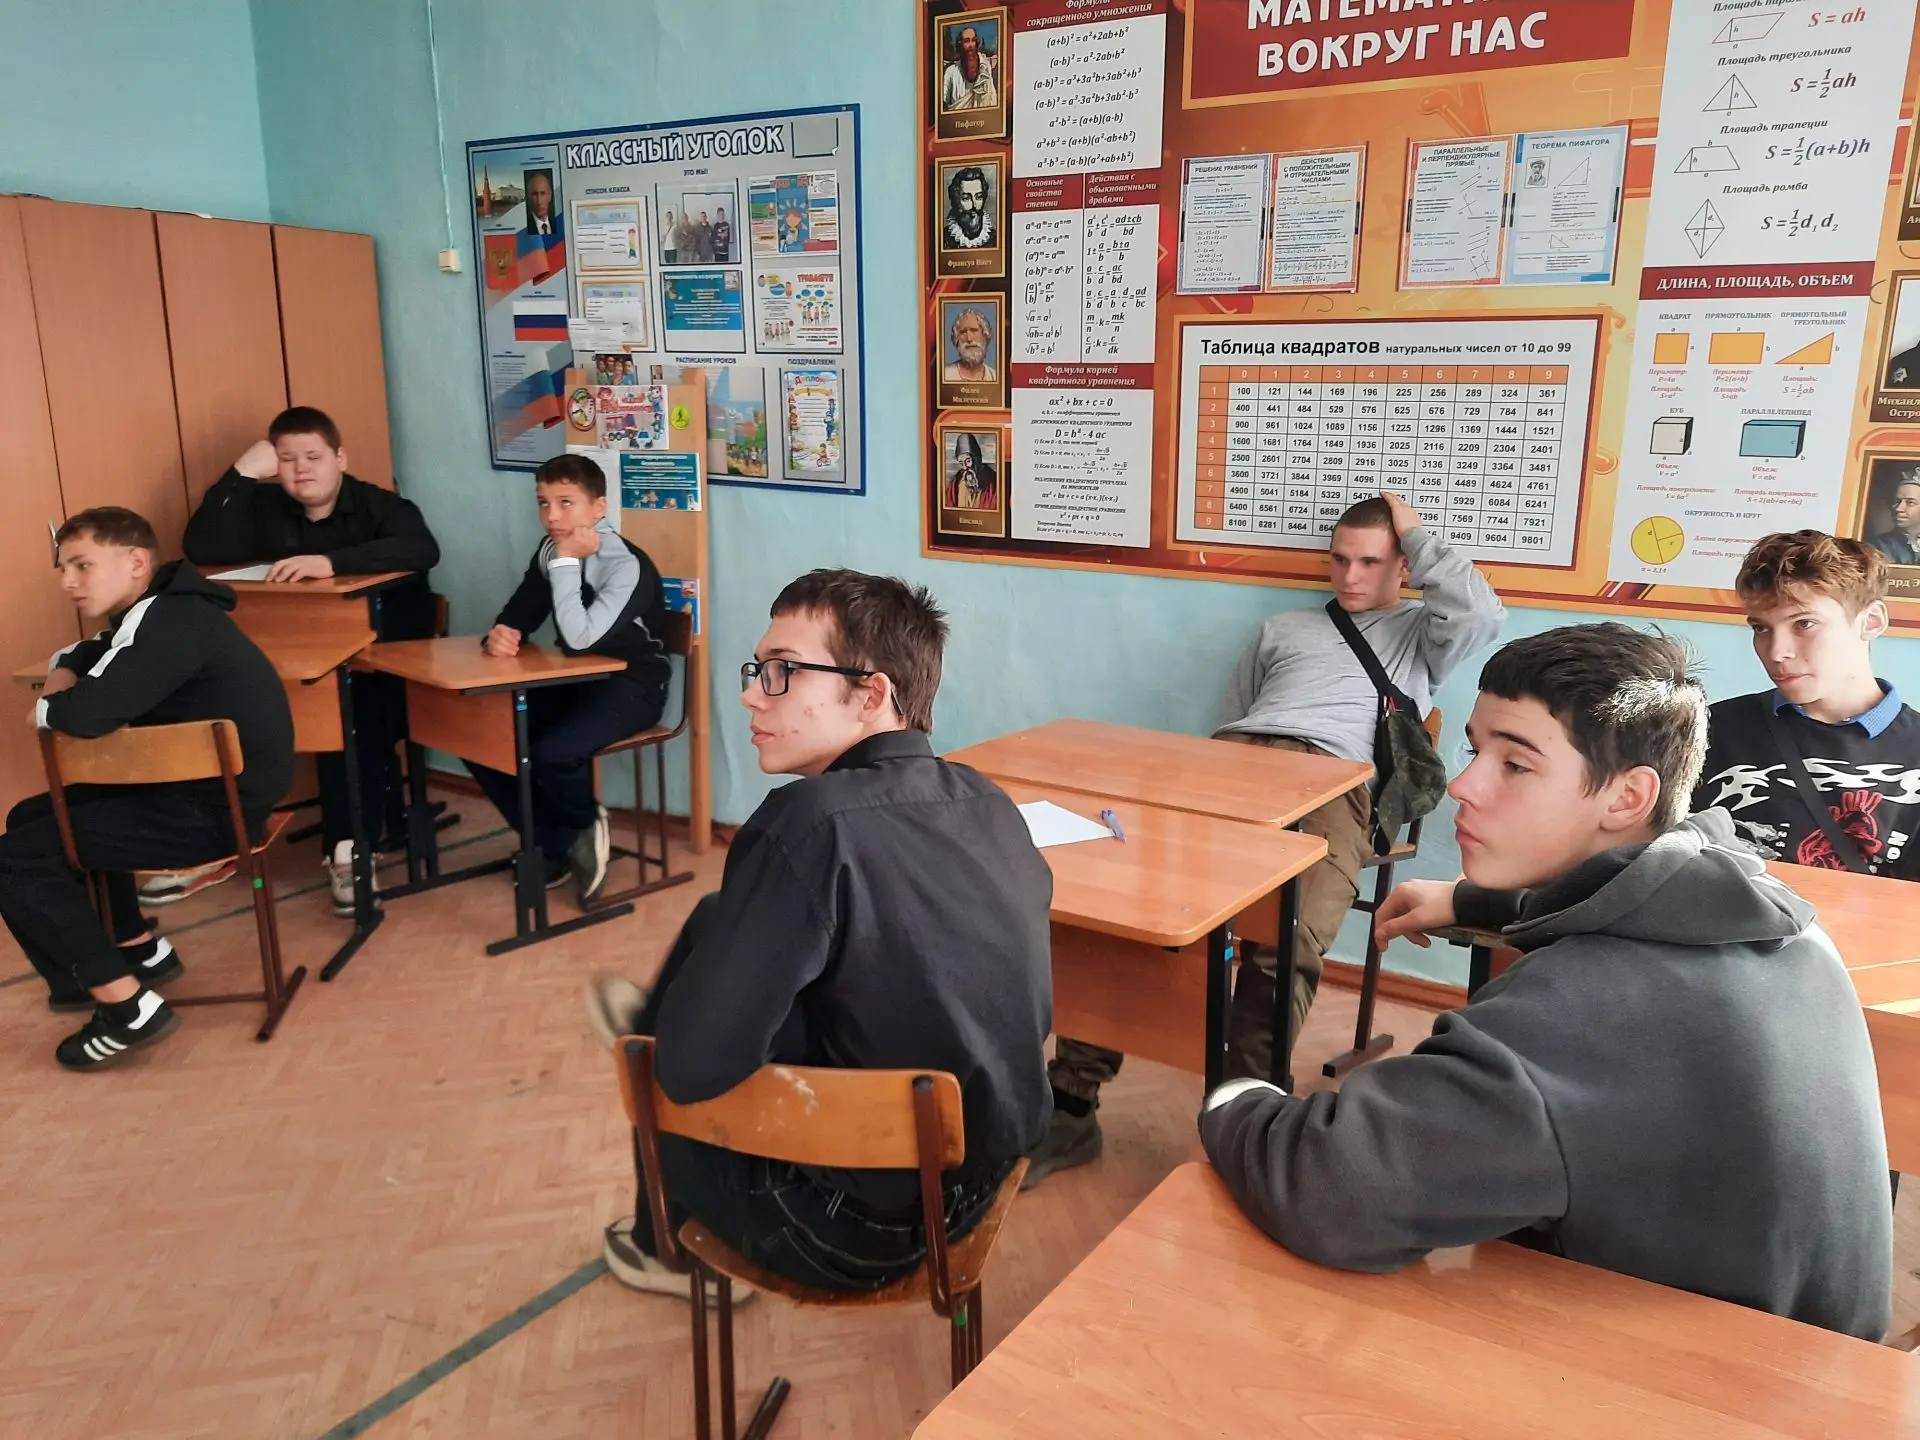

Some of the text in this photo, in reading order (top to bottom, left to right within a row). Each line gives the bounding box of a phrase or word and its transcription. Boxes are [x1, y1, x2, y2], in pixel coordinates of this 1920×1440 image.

[1026, 3, 1153, 27] сокращенного умножения
[1258, 12, 1547, 77] ВОКРУГ НАС
[1717, 45, 1852, 67] Площадь треугольника
[955, 120, 985, 129] Пифагор
[1720, 119, 1828, 135] Площадь трапеции
[566, 124, 784, 169] КЛАССНЫЙ УГОЛОК
[1532, 138, 1610, 150] ТЕОРЕМА ПИФАГОРА
[1433, 145, 1489, 155] ПАРАЛЛЕЛЬНЫЕ
[1195, 163, 1258, 173] РЕШЕНИЕ УРАВНЕНИЙ
[1289, 169, 1349, 178] ОТРИЦАТЕЛЬНЫМИ
[1025, 178, 1064, 188] Основные
[1088, 174, 1129, 184] Действия
[1025, 189, 1062, 198] свойства
[1088, 183, 1157, 194] обыкновенными
[1722, 182, 1808, 195] Площадь ромба
[1088, 196, 1124, 205] дробями
[1656, 274, 1854, 291] ДЛИНА, ПЛОЩАДЬ, ОБЪЕМ
[1705, 312, 1773, 320] ПРЯМОУГОЛЬНИК
[1201, 339, 1572, 358] Таблица квадратов натуральных чисел от 10 до 99
[1045, 366, 1118, 378] Формула корней
[1028, 376, 1135, 387] квадратного уравнения
[1237, 387, 1251, 395] 100
[1330, 388, 1345, 396] 169
[1363, 388, 1377, 396] 196
[1396, 388, 1412, 396] 225
[1430, 389, 1446, 397] 256
[1465, 389, 1482, 397] 289
[1501, 389, 1518, 397] 324
[1539, 389, 1555, 398] 361
[1329, 405, 1344, 413] 529
[1394, 406, 1410, 414] 625
[1429, 407, 1445, 415] 676
[1464, 407, 1480, 415] 729
[1500, 408, 1516, 416] 784
[1537, 408, 1553, 416] 841
[1391, 424, 1411, 432] 1225
[1425, 425, 1446, 433] 1296
[1460, 425, 1481, 433] 1369
[1496, 426, 1517, 434] 1444
[1533, 427, 1554, 435] 1521
[1233, 437, 1250, 445] 1600
[1263, 438, 1281, 446] 1681
[1293, 439, 1311, 447] 1764
[1325, 440, 1344, 448] 1849
[1357, 441, 1376, 449] 1936
[1424, 442, 1444, 451] 2116
[1458, 443, 1480, 451] 2209
[1493, 444, 1515, 452] 2304
[1530, 445, 1552, 453] 2401
[1232, 454, 1550, 472] 2500 2601 2704 2809 2916 3025 3136 3249 3364 3481
[1684, 509, 1734, 518] ОКРУЖНОСТЬ
[1742, 512, 1762, 520] КРУГ
